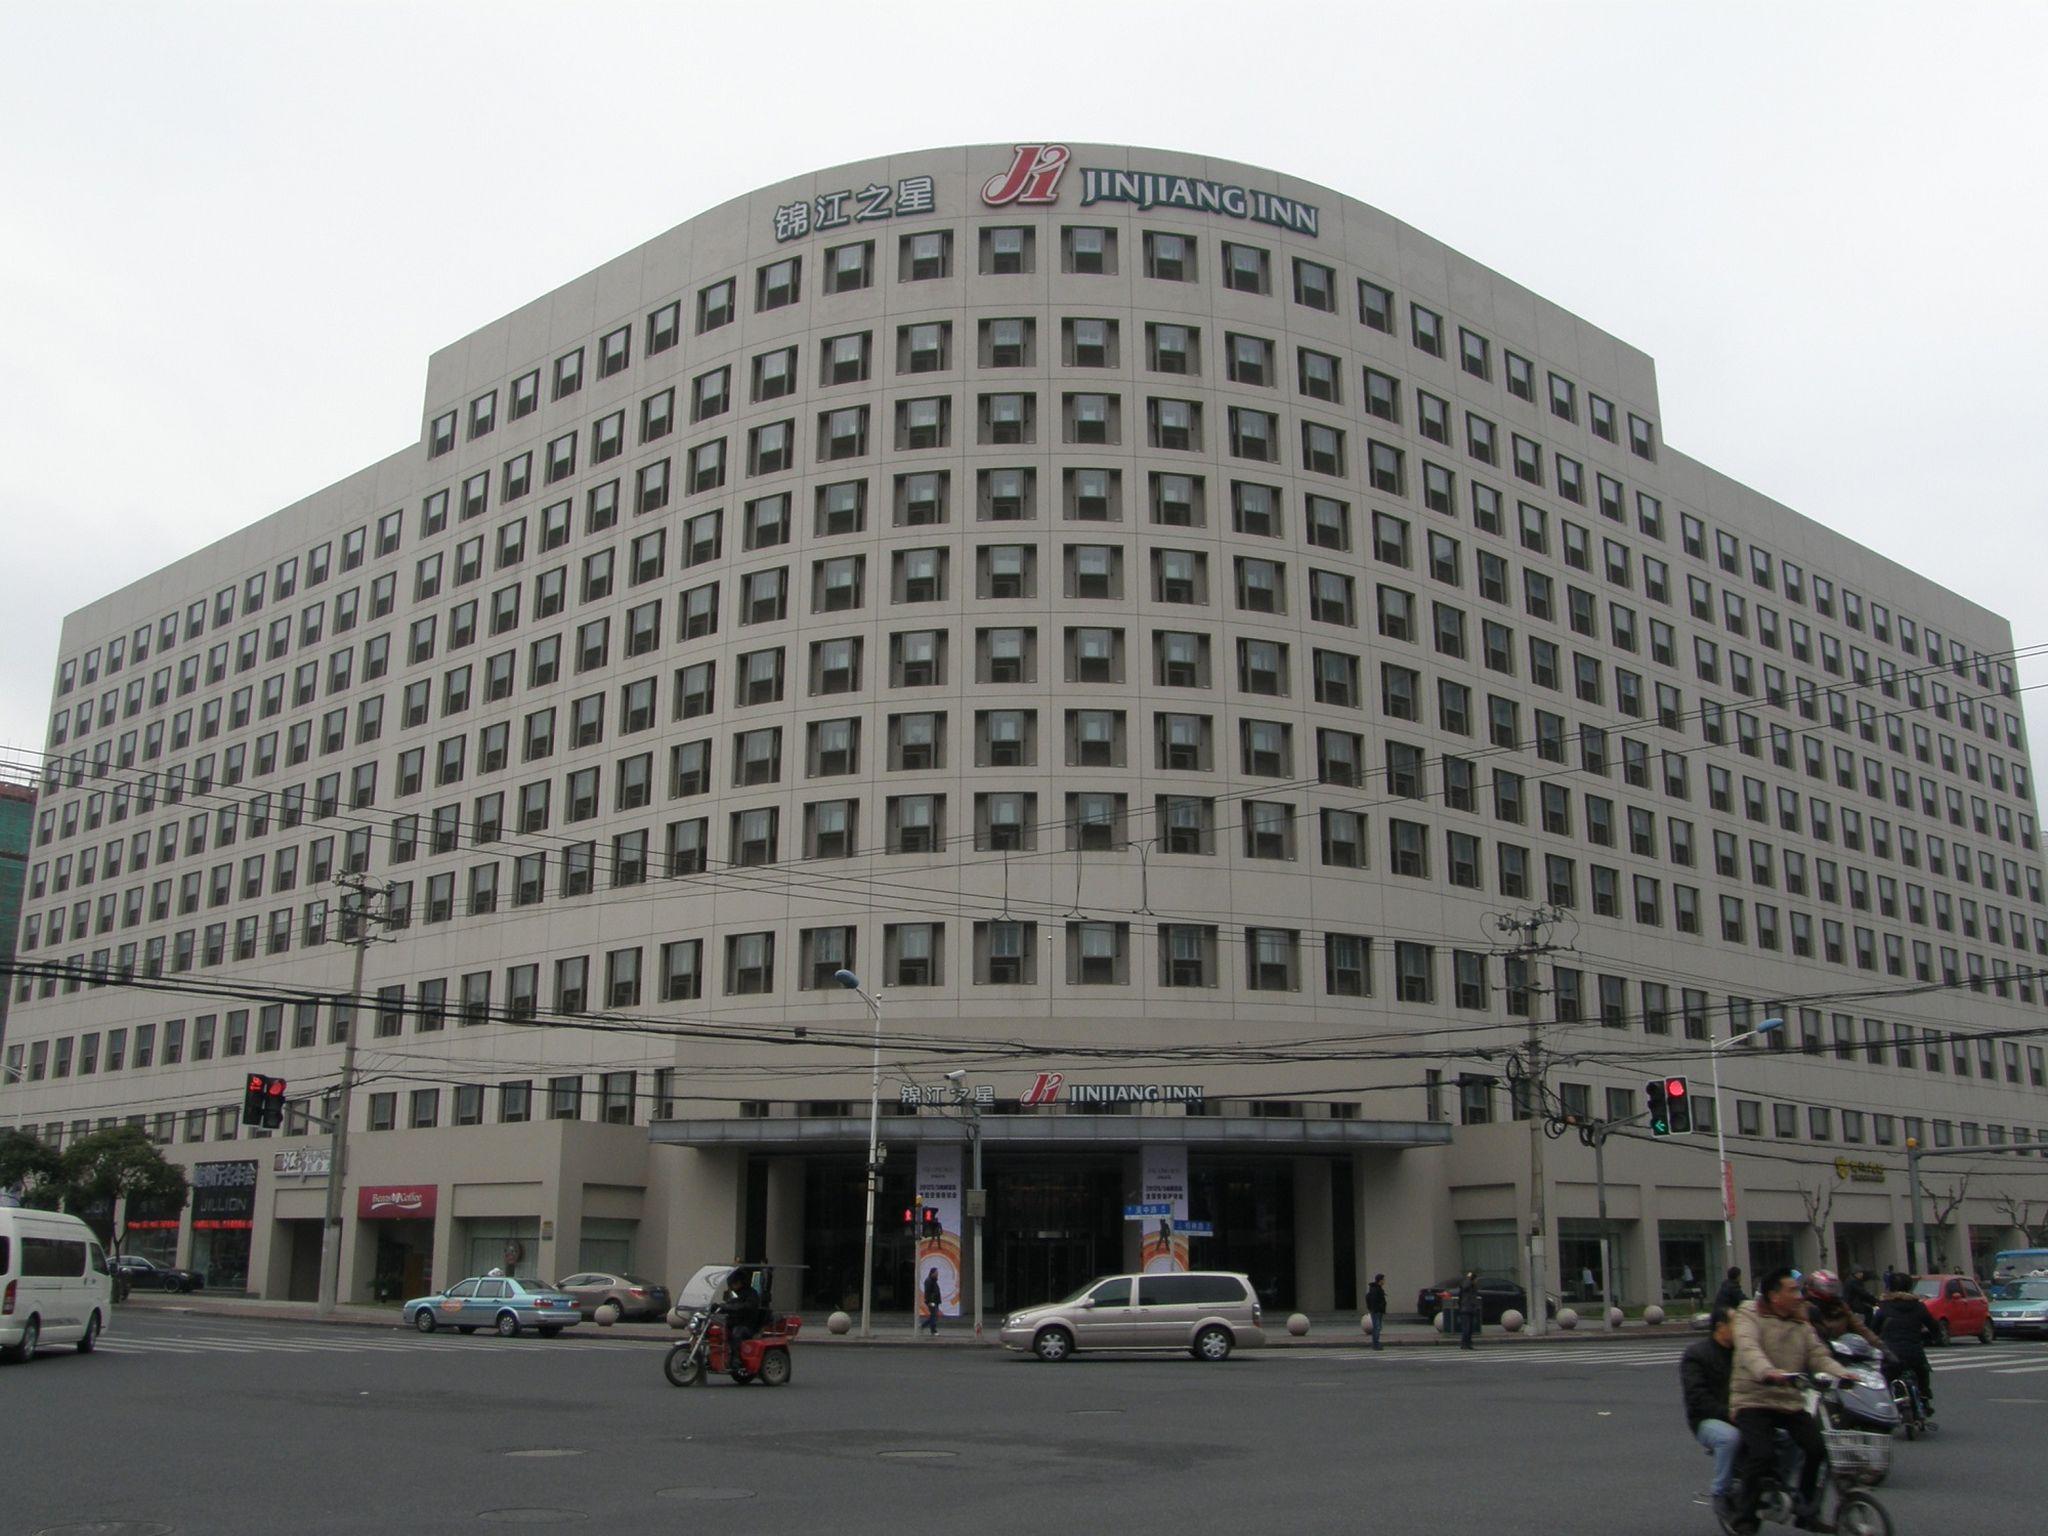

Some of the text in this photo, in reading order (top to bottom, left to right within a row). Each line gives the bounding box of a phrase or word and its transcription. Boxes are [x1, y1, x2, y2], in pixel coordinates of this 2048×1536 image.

[773, 175, 935, 243] 锦江之星
[1081, 168, 1319, 238] JINJIANG INN
[1069, 1085, 1204, 1105] JINJIANG INN
